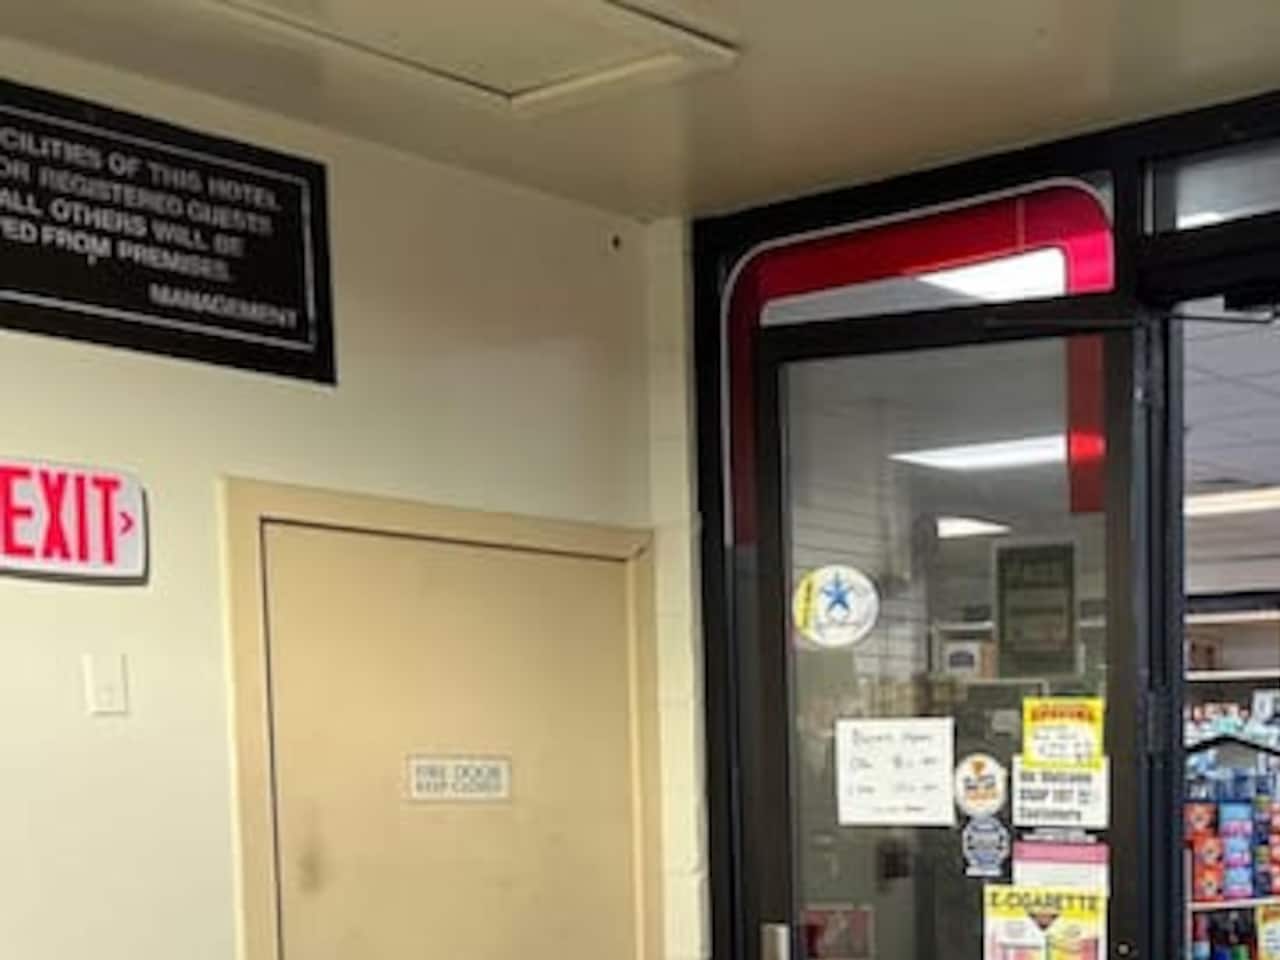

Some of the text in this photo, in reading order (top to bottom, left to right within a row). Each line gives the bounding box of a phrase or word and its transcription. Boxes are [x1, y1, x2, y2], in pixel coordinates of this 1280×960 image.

[107, 150, 143, 179] OF
[147, 160, 204, 194] THIS
[41, 225, 113, 258] FROM
[51, 197, 148, 238] OTHERS
[151, 219, 209, 251] WILL
[212, 232, 245, 258] BE
[149, 282, 297, 329] MANAGEMENT
[0, 464, 121, 565] EXIT
